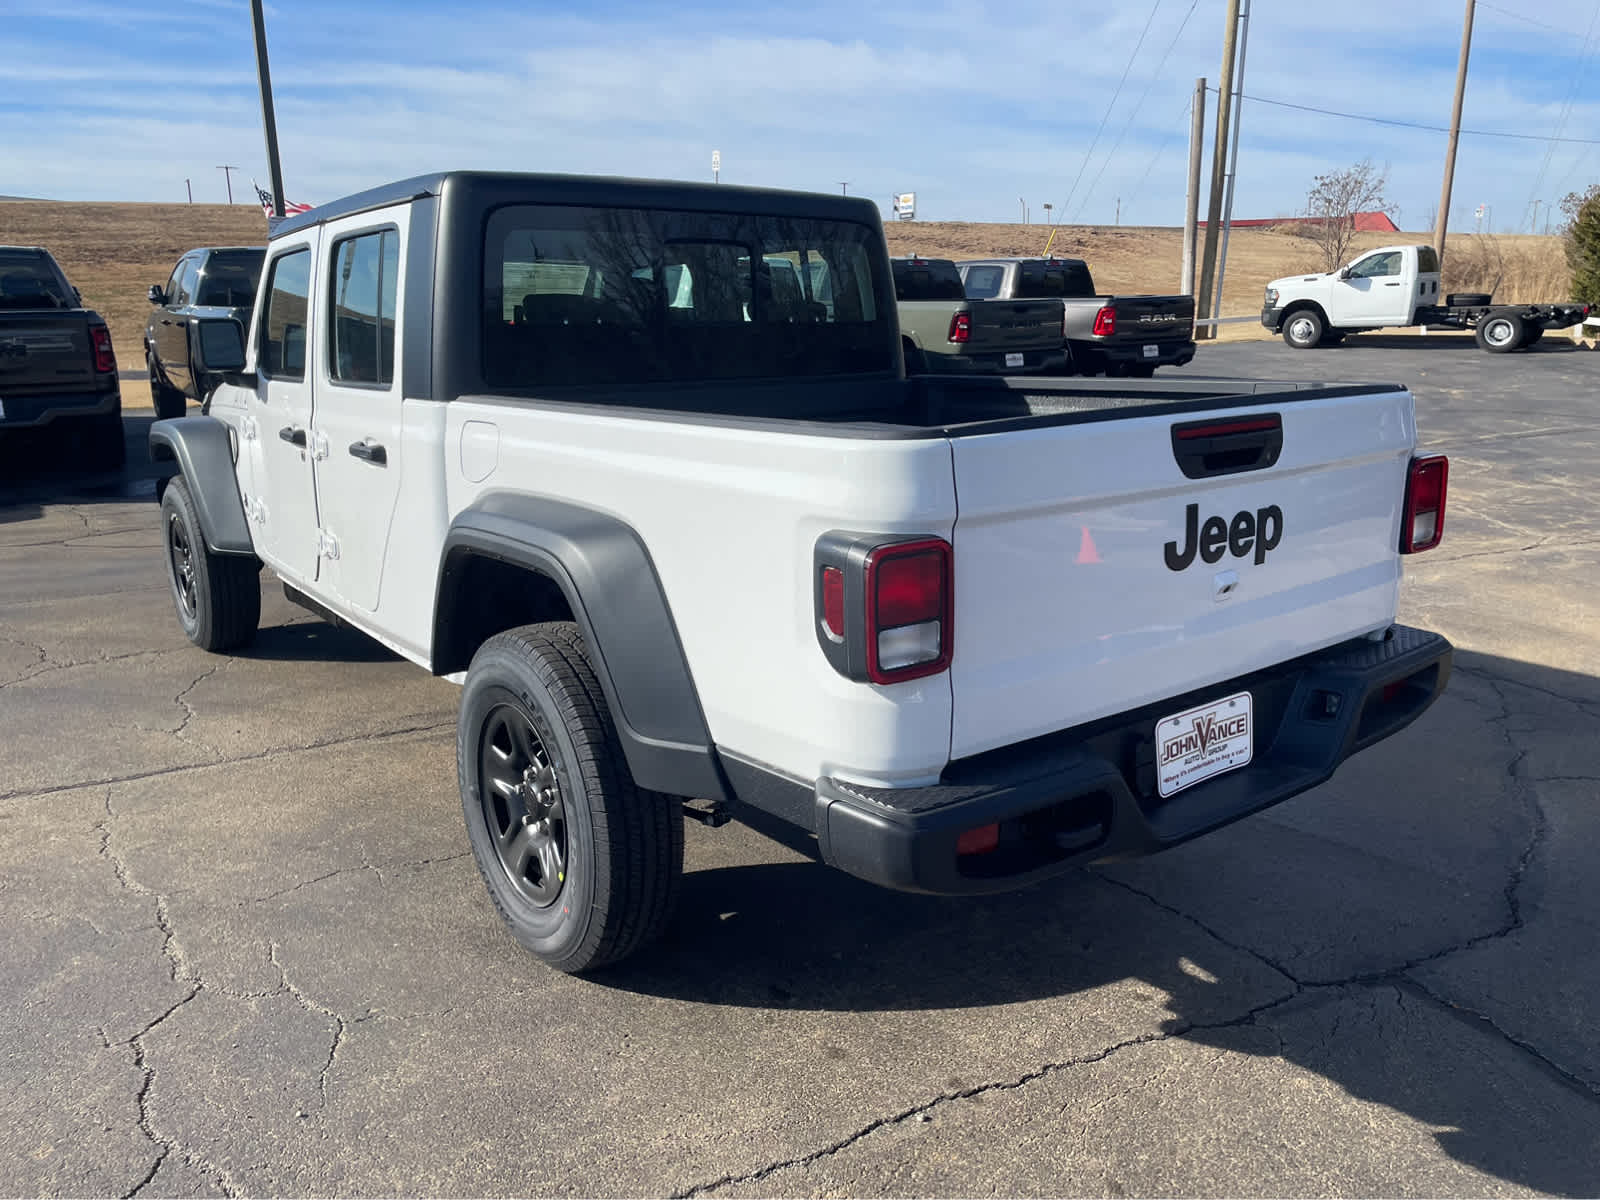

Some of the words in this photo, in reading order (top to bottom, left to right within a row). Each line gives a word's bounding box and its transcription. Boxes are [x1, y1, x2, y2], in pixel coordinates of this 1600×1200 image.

[1140, 313, 1176, 322] RAM
[1164, 503, 1283, 572] Jeep
[1163, 733, 1198, 762] JOHN
[1196, 716, 1246, 754] VANCE
